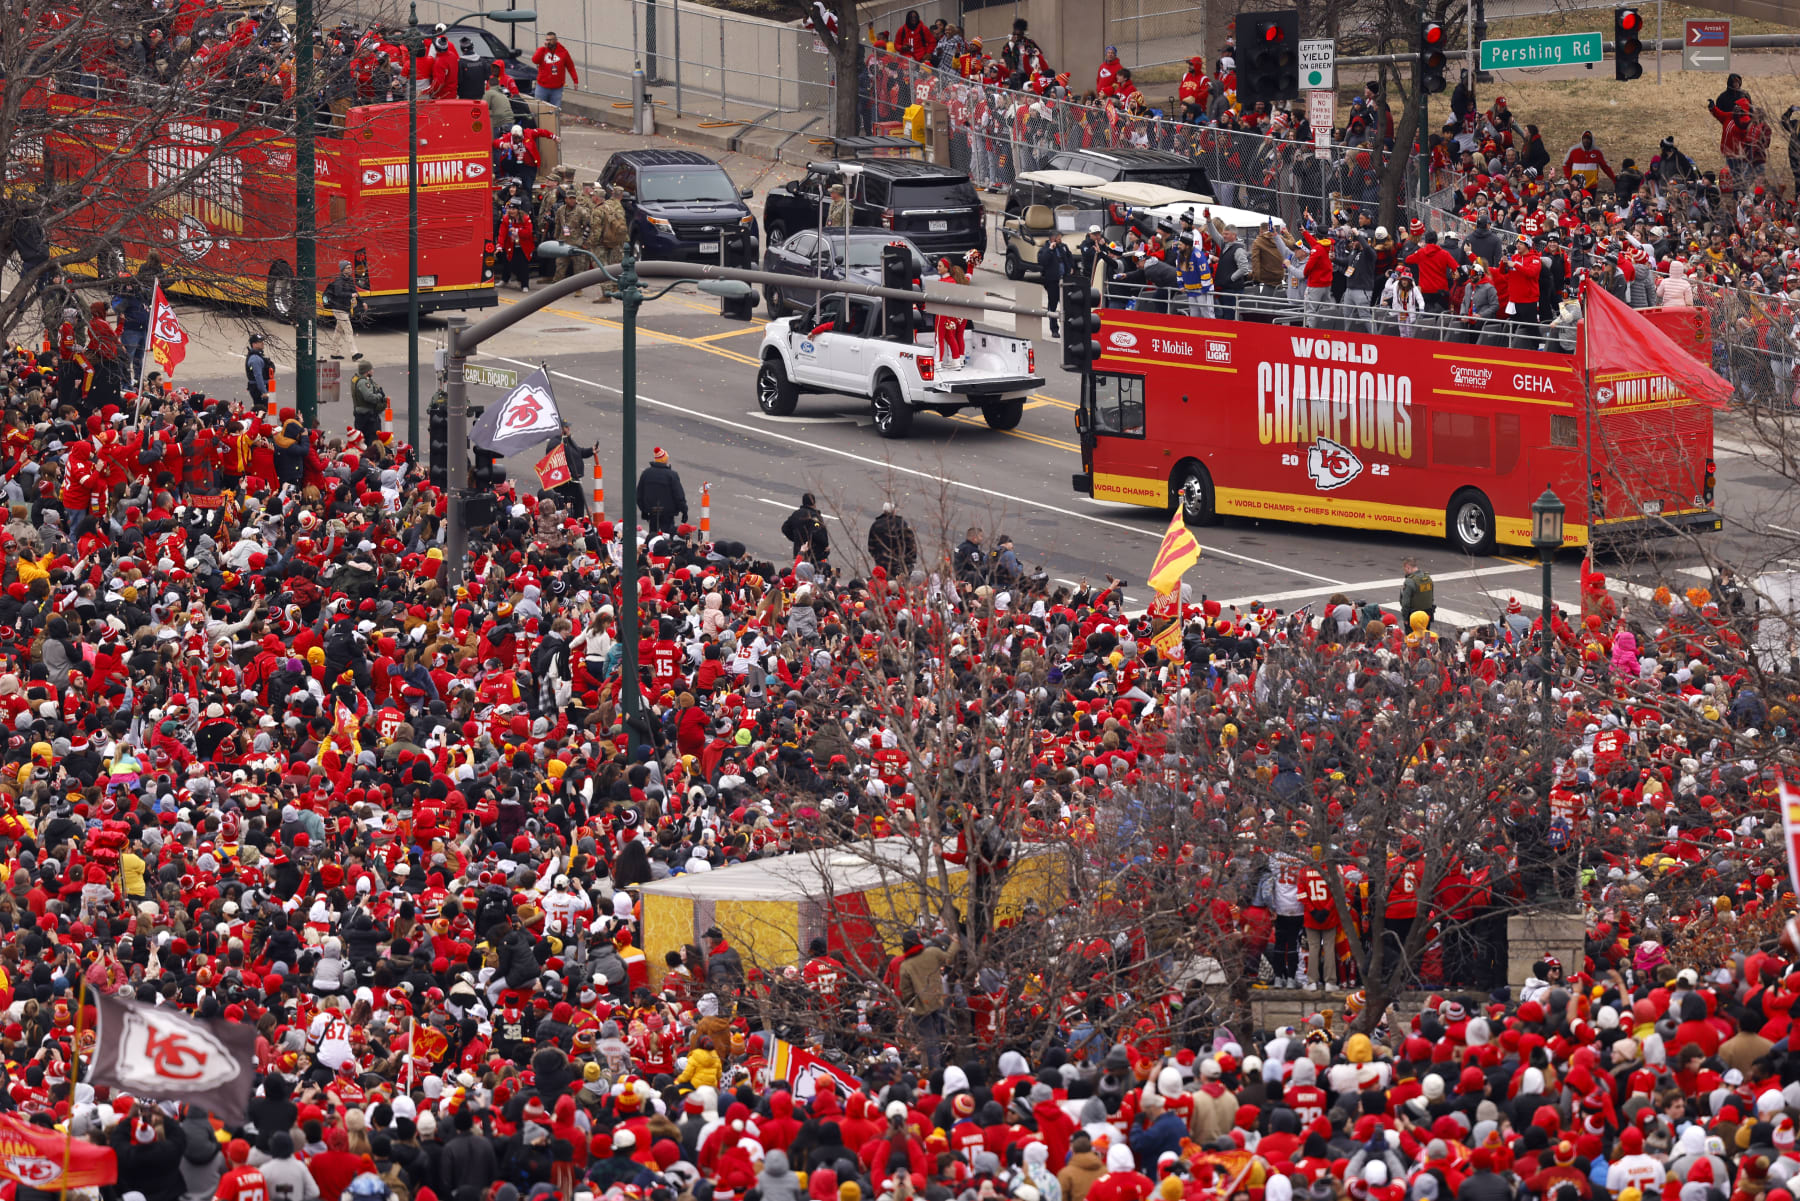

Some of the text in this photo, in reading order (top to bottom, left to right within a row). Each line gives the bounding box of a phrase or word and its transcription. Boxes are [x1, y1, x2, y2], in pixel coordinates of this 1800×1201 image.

[1300, 43, 1333, 52] LEFT TURN
[1303, 52, 1330, 61] YIELD
[1492, 40, 1591, 63] Pershing Rd
[384, 163, 418, 187] WOR
[422, 160, 464, 185] CHAMPS
[1162, 339, 1193, 355] Mobile
[1207, 350, 1230, 361] LIGHT
[1209, 342, 1227, 352] BUD
[1291, 336, 1378, 365] WORLD
[465, 368, 481, 382] CARL
[1450, 364, 1492, 380] Community
[1454, 370, 1487, 386] America
[1513, 373, 1554, 394] GEHA
[1616, 378, 1647, 405] WORLD
[1257, 361, 1412, 460] CHAMPIONS
[1281, 450, 1390, 478] 20 KC 22
[1094, 483, 1154, 497] WORLD CHAMPS
[1234, 499, 1437, 527] WORLD CHAMPS CHIEFS KINGDOM WORLD CHAMPS
[656, 658, 673, 676] 15
[381, 720, 401, 739] 87
[1308, 880, 1328, 901] 15
[325, 1023, 345, 1041] 87
[146, 1024, 208, 1080] KC
